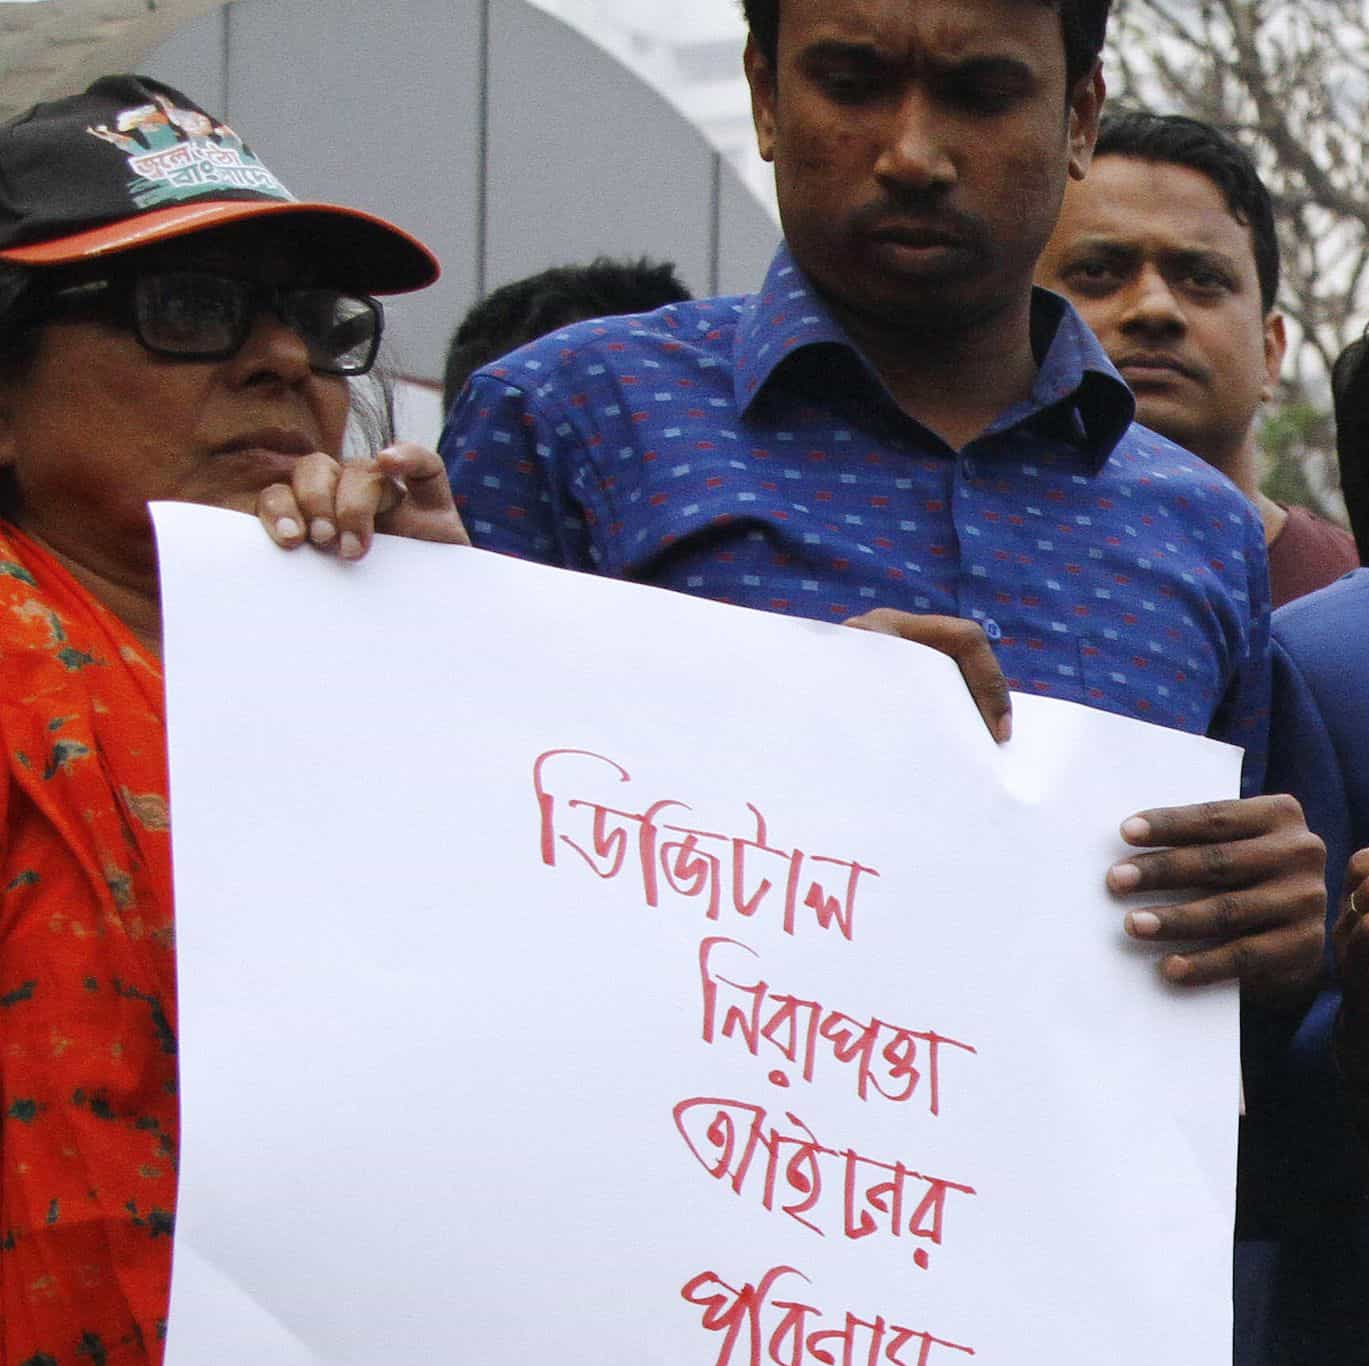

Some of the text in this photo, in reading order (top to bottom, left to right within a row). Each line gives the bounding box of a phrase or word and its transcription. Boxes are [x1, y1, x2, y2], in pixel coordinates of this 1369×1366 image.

[533, 749, 880, 945] ডিজিটাল
[690, 932, 977, 1118] নিরাপত্তা
[672, 1094, 977, 1272] আইনের
